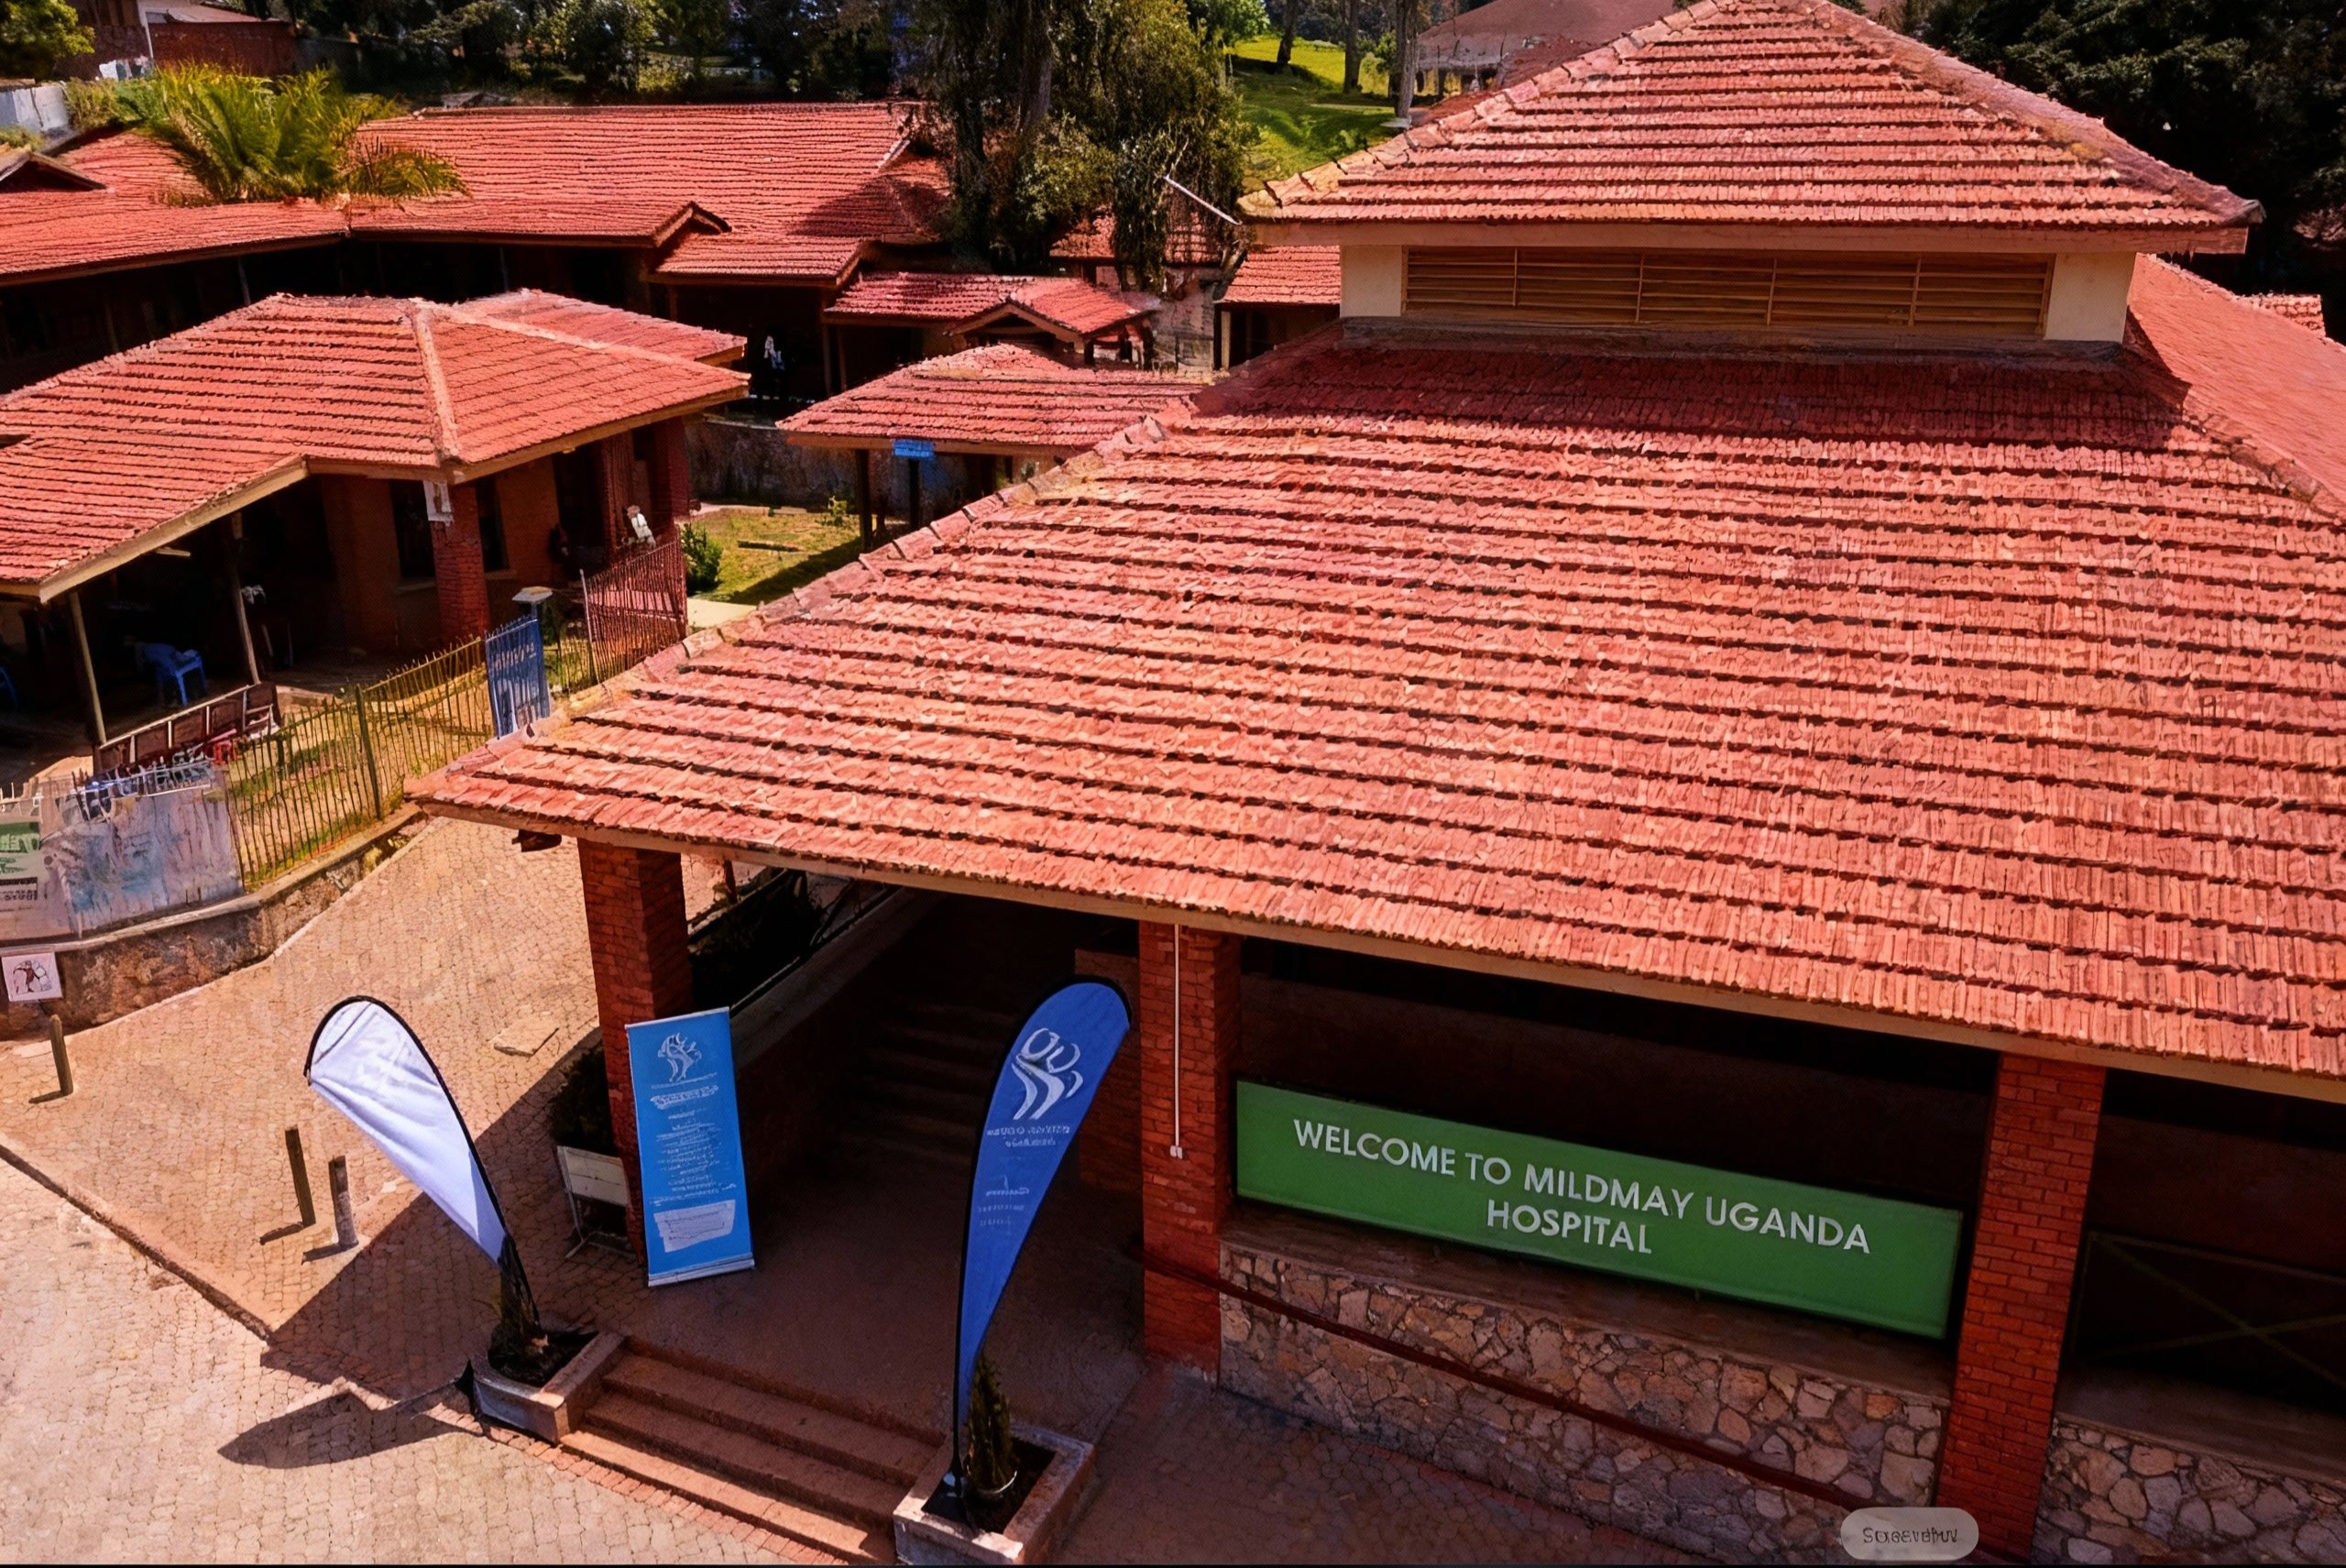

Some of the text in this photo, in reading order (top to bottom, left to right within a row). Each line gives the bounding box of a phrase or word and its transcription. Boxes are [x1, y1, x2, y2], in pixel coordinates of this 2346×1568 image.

[1293, 1119, 1869, 1254] WELCOME TO MILDMAY UGANDA
[1486, 1199, 1652, 1254] HOSPITAL
